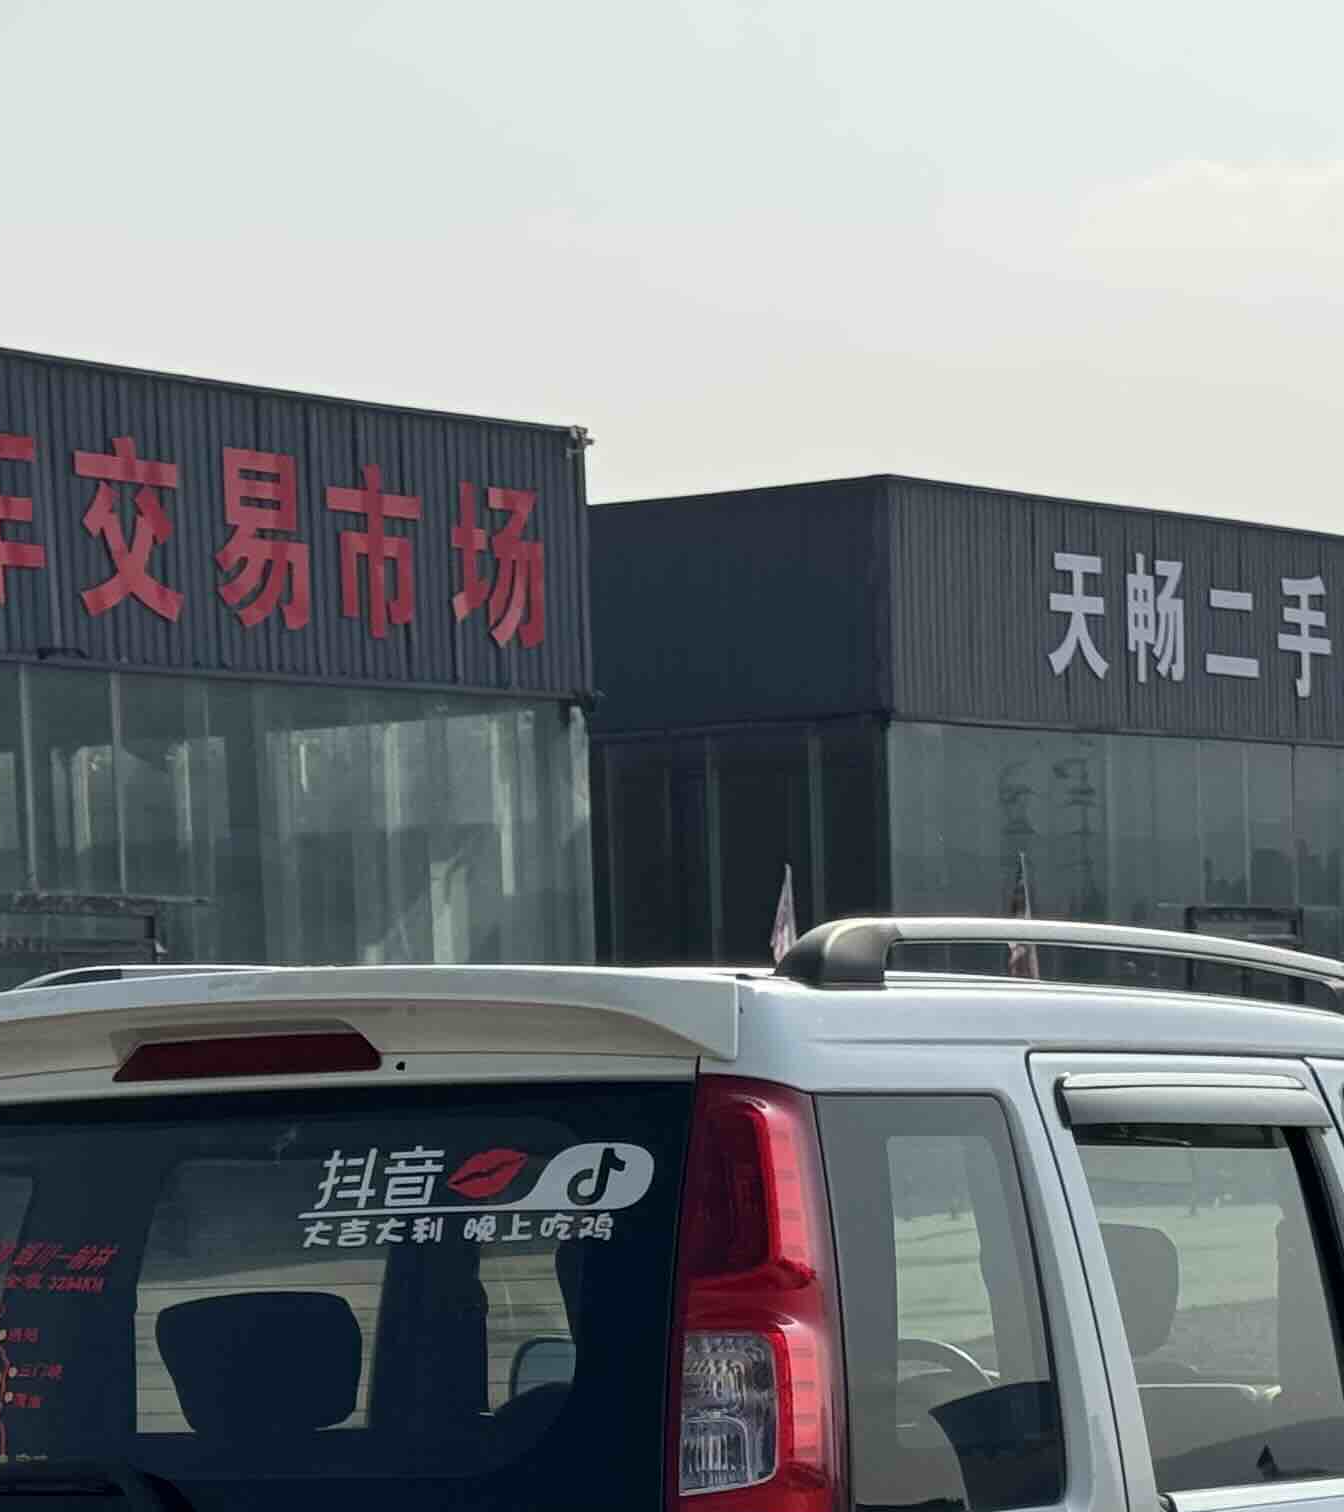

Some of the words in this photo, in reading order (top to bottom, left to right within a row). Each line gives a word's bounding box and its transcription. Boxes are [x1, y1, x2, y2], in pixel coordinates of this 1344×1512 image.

[313, 1145, 446, 1210] 抖音
[303, 1216, 444, 1248] 大吉大利
[462, 1213, 614, 1243] 晚上吃鸡
